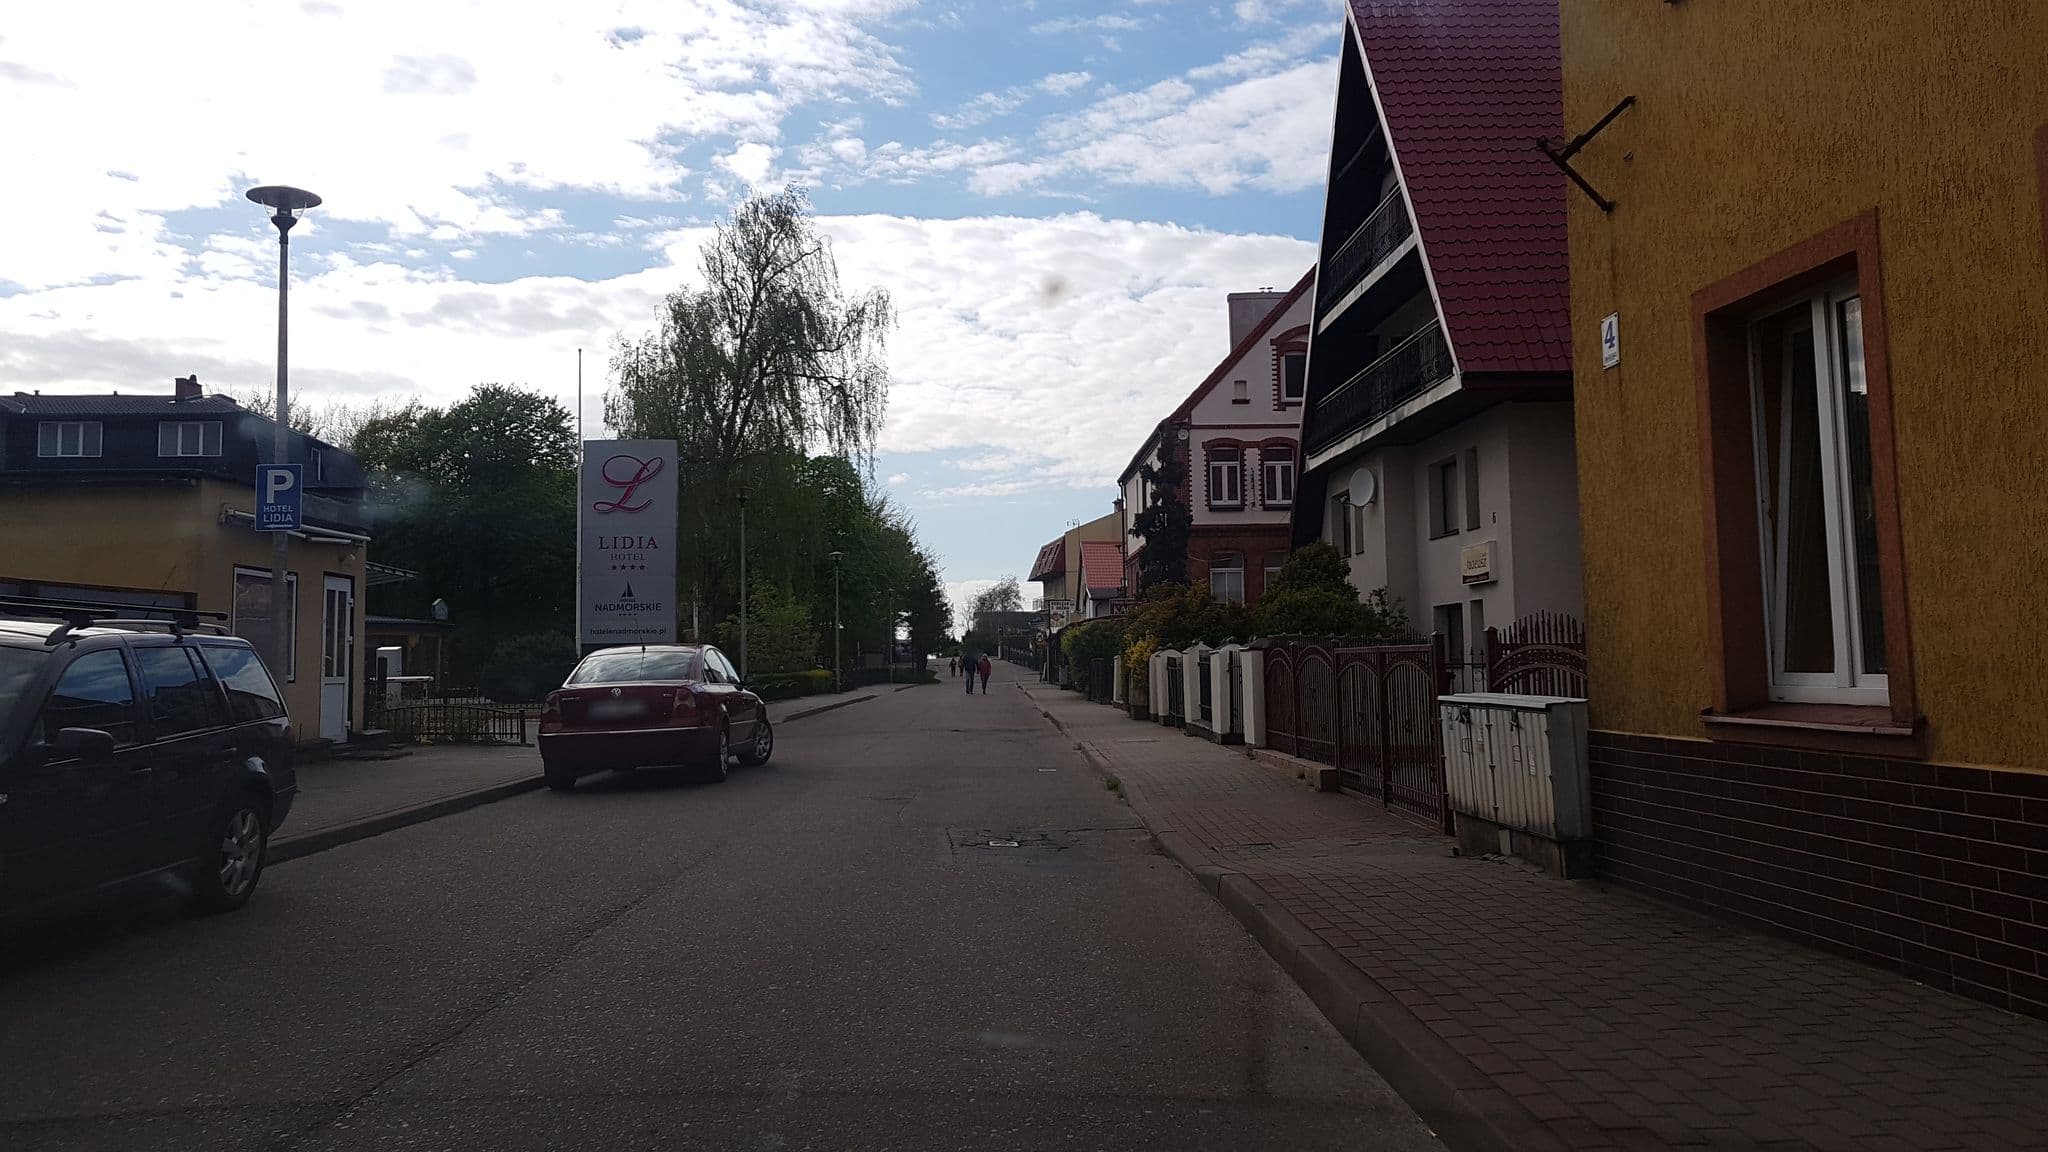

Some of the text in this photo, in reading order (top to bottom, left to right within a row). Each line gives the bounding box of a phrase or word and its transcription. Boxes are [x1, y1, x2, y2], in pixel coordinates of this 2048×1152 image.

[1604, 320, 1616, 350] 4
[267, 469, 295, 503] P
[263, 504, 294, 513] HOTEL
[263, 513, 293, 523] LIDIA
[599, 535, 659, 550] LIDIA
[610, 553, 646, 561] HOTEL
[594, 602, 662, 612] NADMORSKIE
